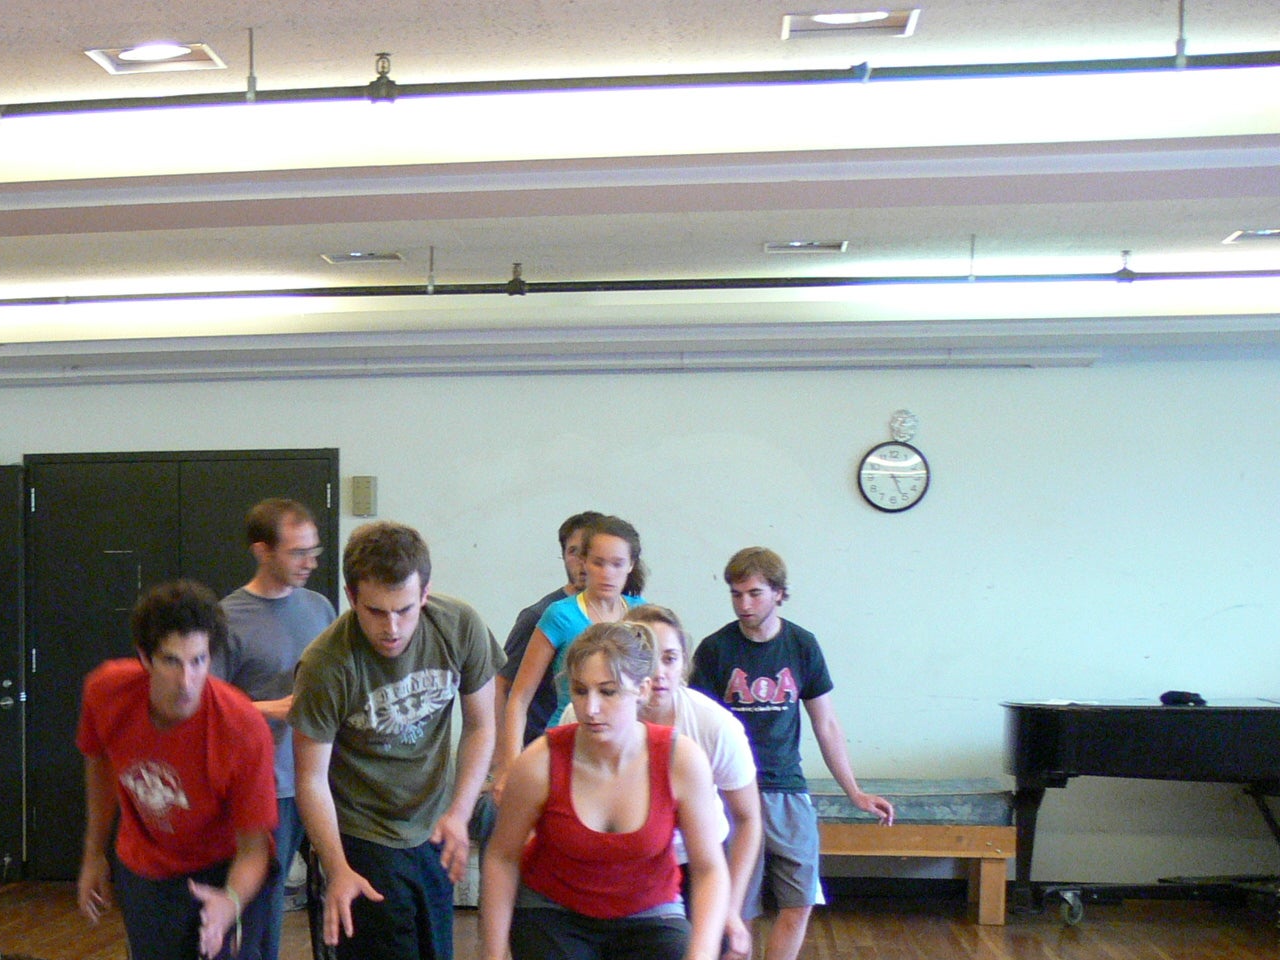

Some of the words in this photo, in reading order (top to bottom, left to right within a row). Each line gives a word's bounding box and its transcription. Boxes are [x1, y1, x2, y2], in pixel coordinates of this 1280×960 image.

[889, 450, 899, 459] 12
[870, 485, 877, 493] 8
[910, 484, 917, 492] 4
[879, 492, 885, 500] 7
[889, 496, 897, 504] 6
[901, 492, 909, 501] 5
